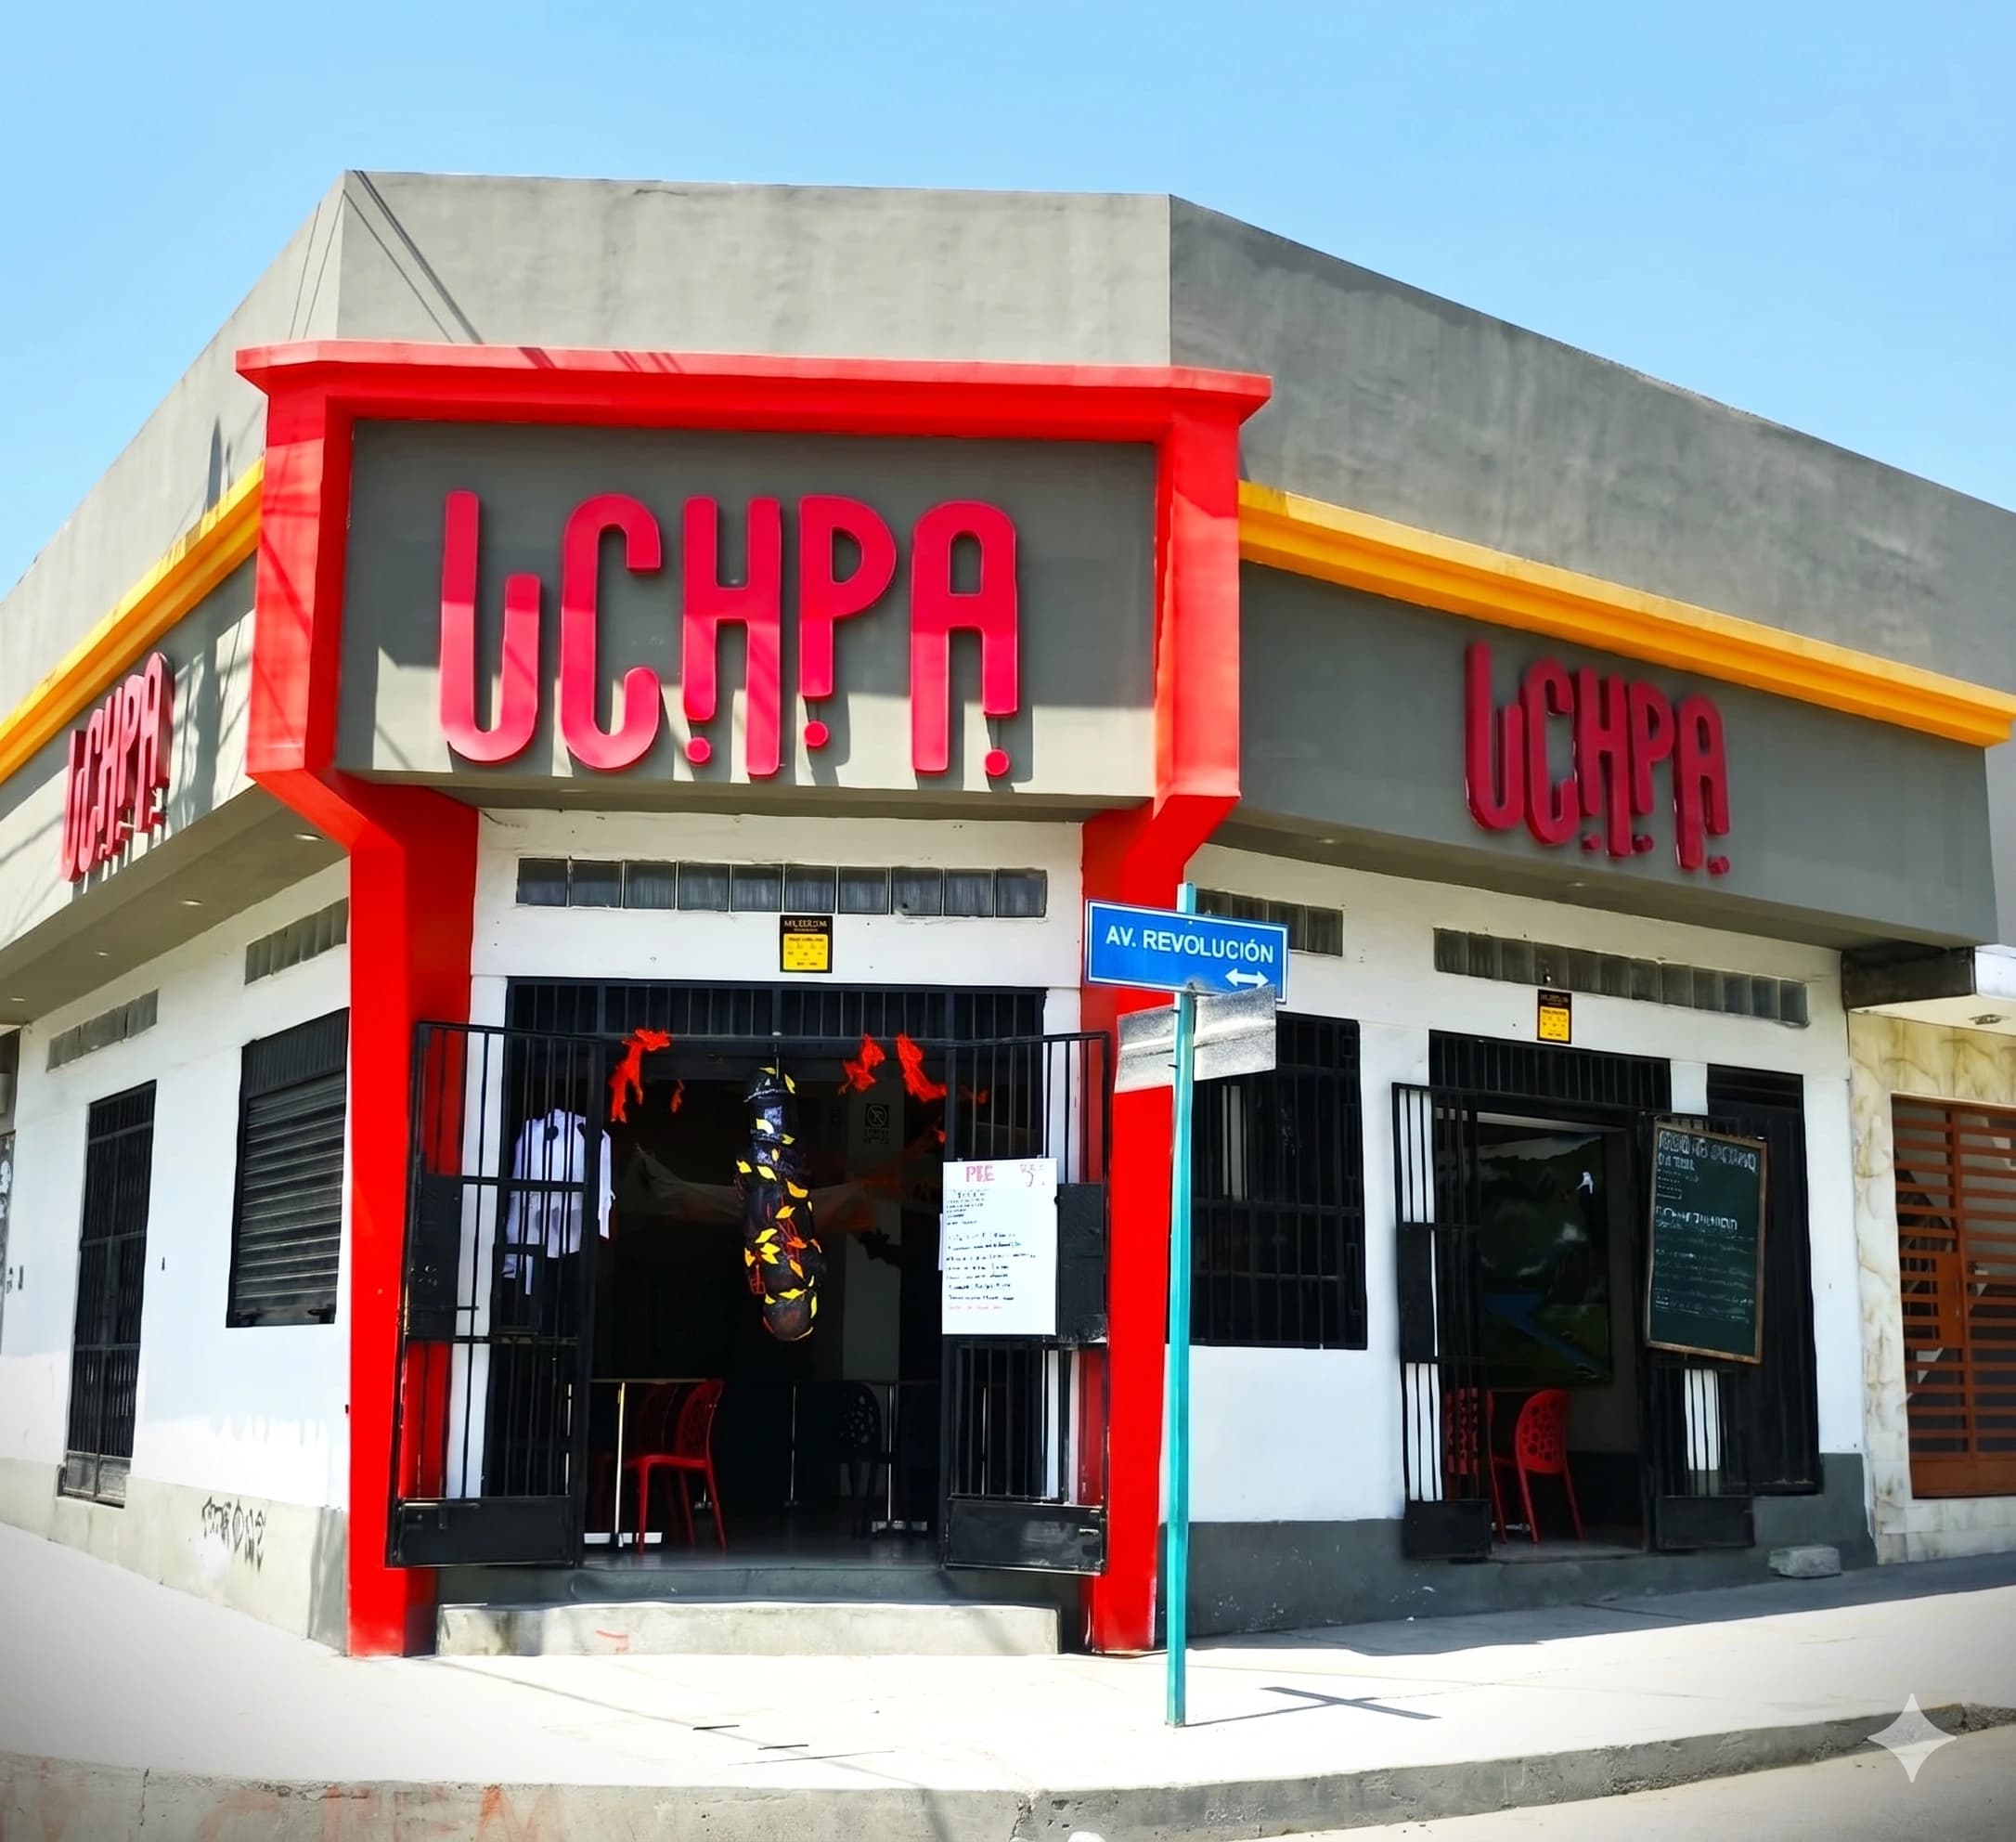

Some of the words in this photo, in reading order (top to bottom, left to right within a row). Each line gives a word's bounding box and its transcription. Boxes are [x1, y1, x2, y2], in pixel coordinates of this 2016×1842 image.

[439, 490, 1019, 777] UCHPA
[1464, 641, 1730, 876] UCHPA
[1105, 926, 1137, 948] AV.
[1143, 929, 1274, 964] REVOLUCIÓN
